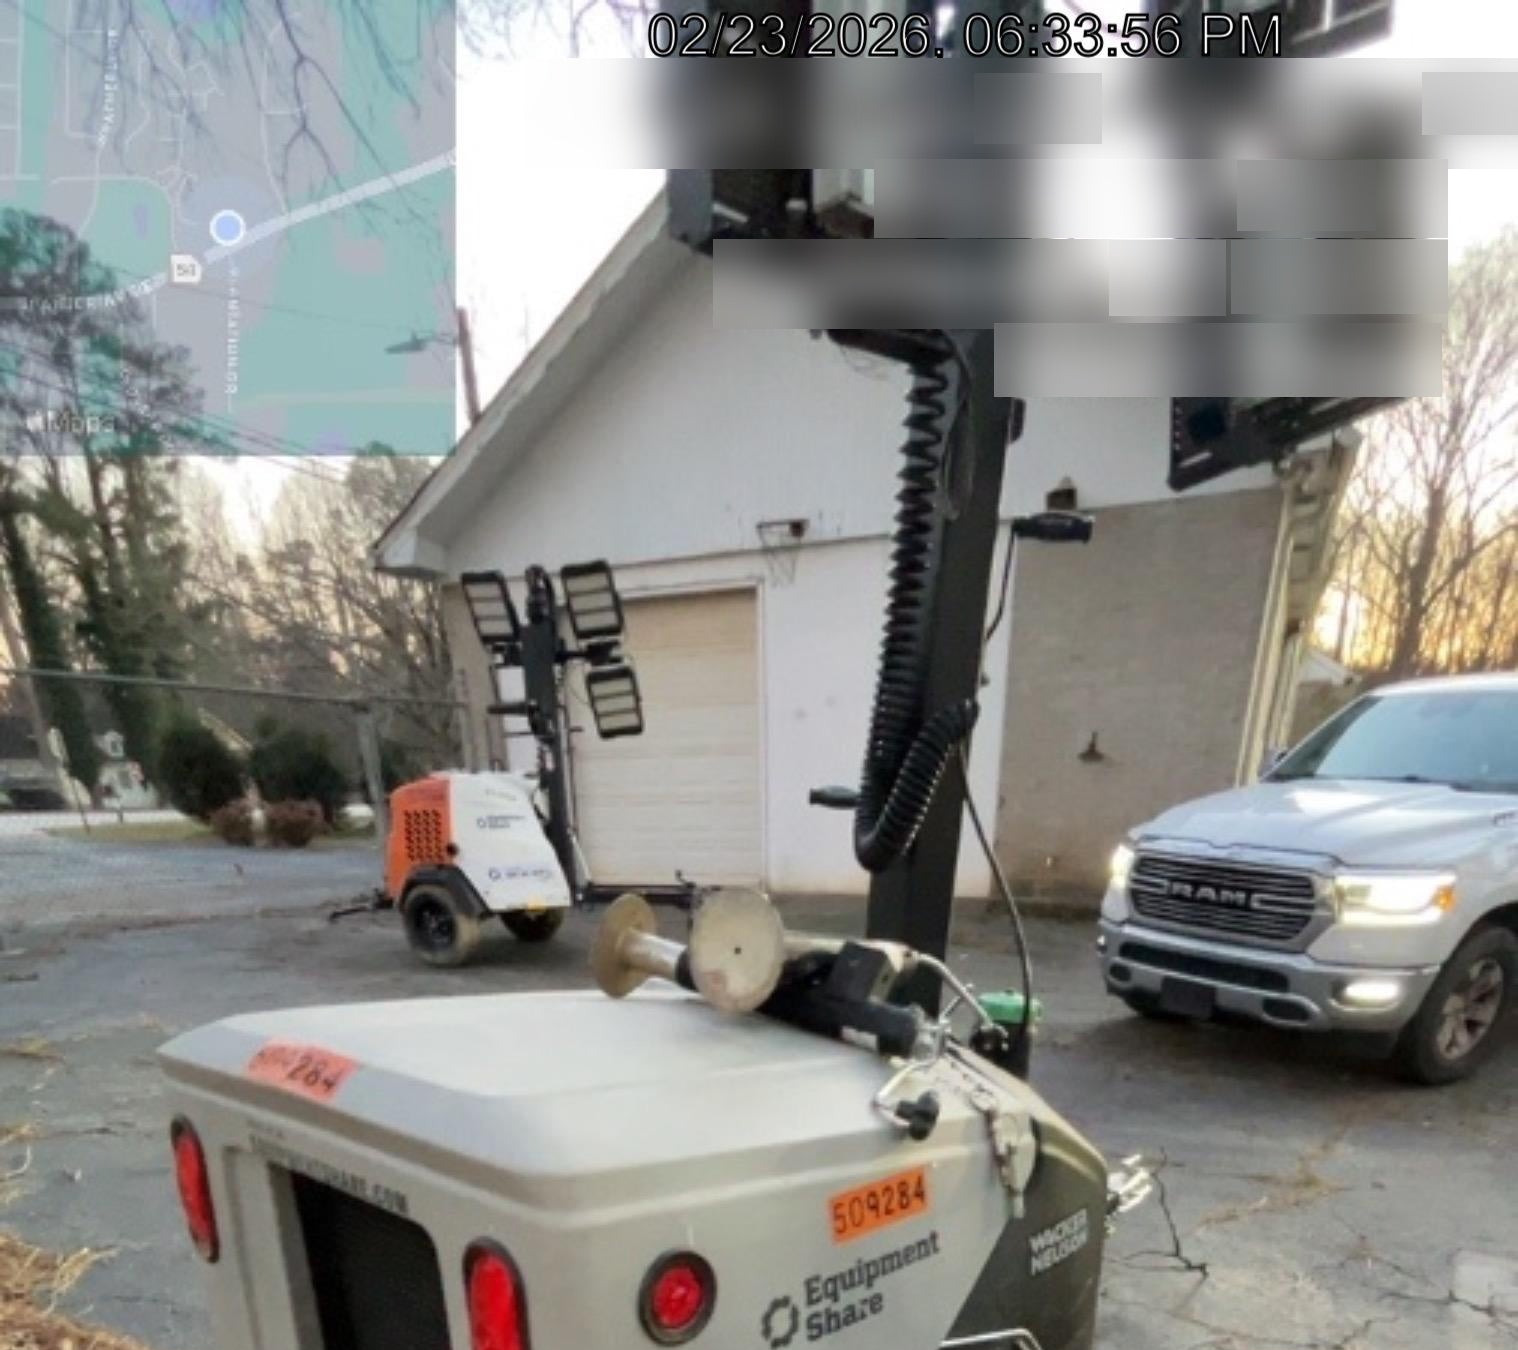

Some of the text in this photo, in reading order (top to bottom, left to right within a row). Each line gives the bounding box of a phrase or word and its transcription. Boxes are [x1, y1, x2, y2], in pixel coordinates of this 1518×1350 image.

[1172, 881, 1246, 907] RAM
[833, 1174, 926, 1235] 509284
[804, 1230, 940, 1308] Equipment
[806, 1291, 884, 1342] Share
